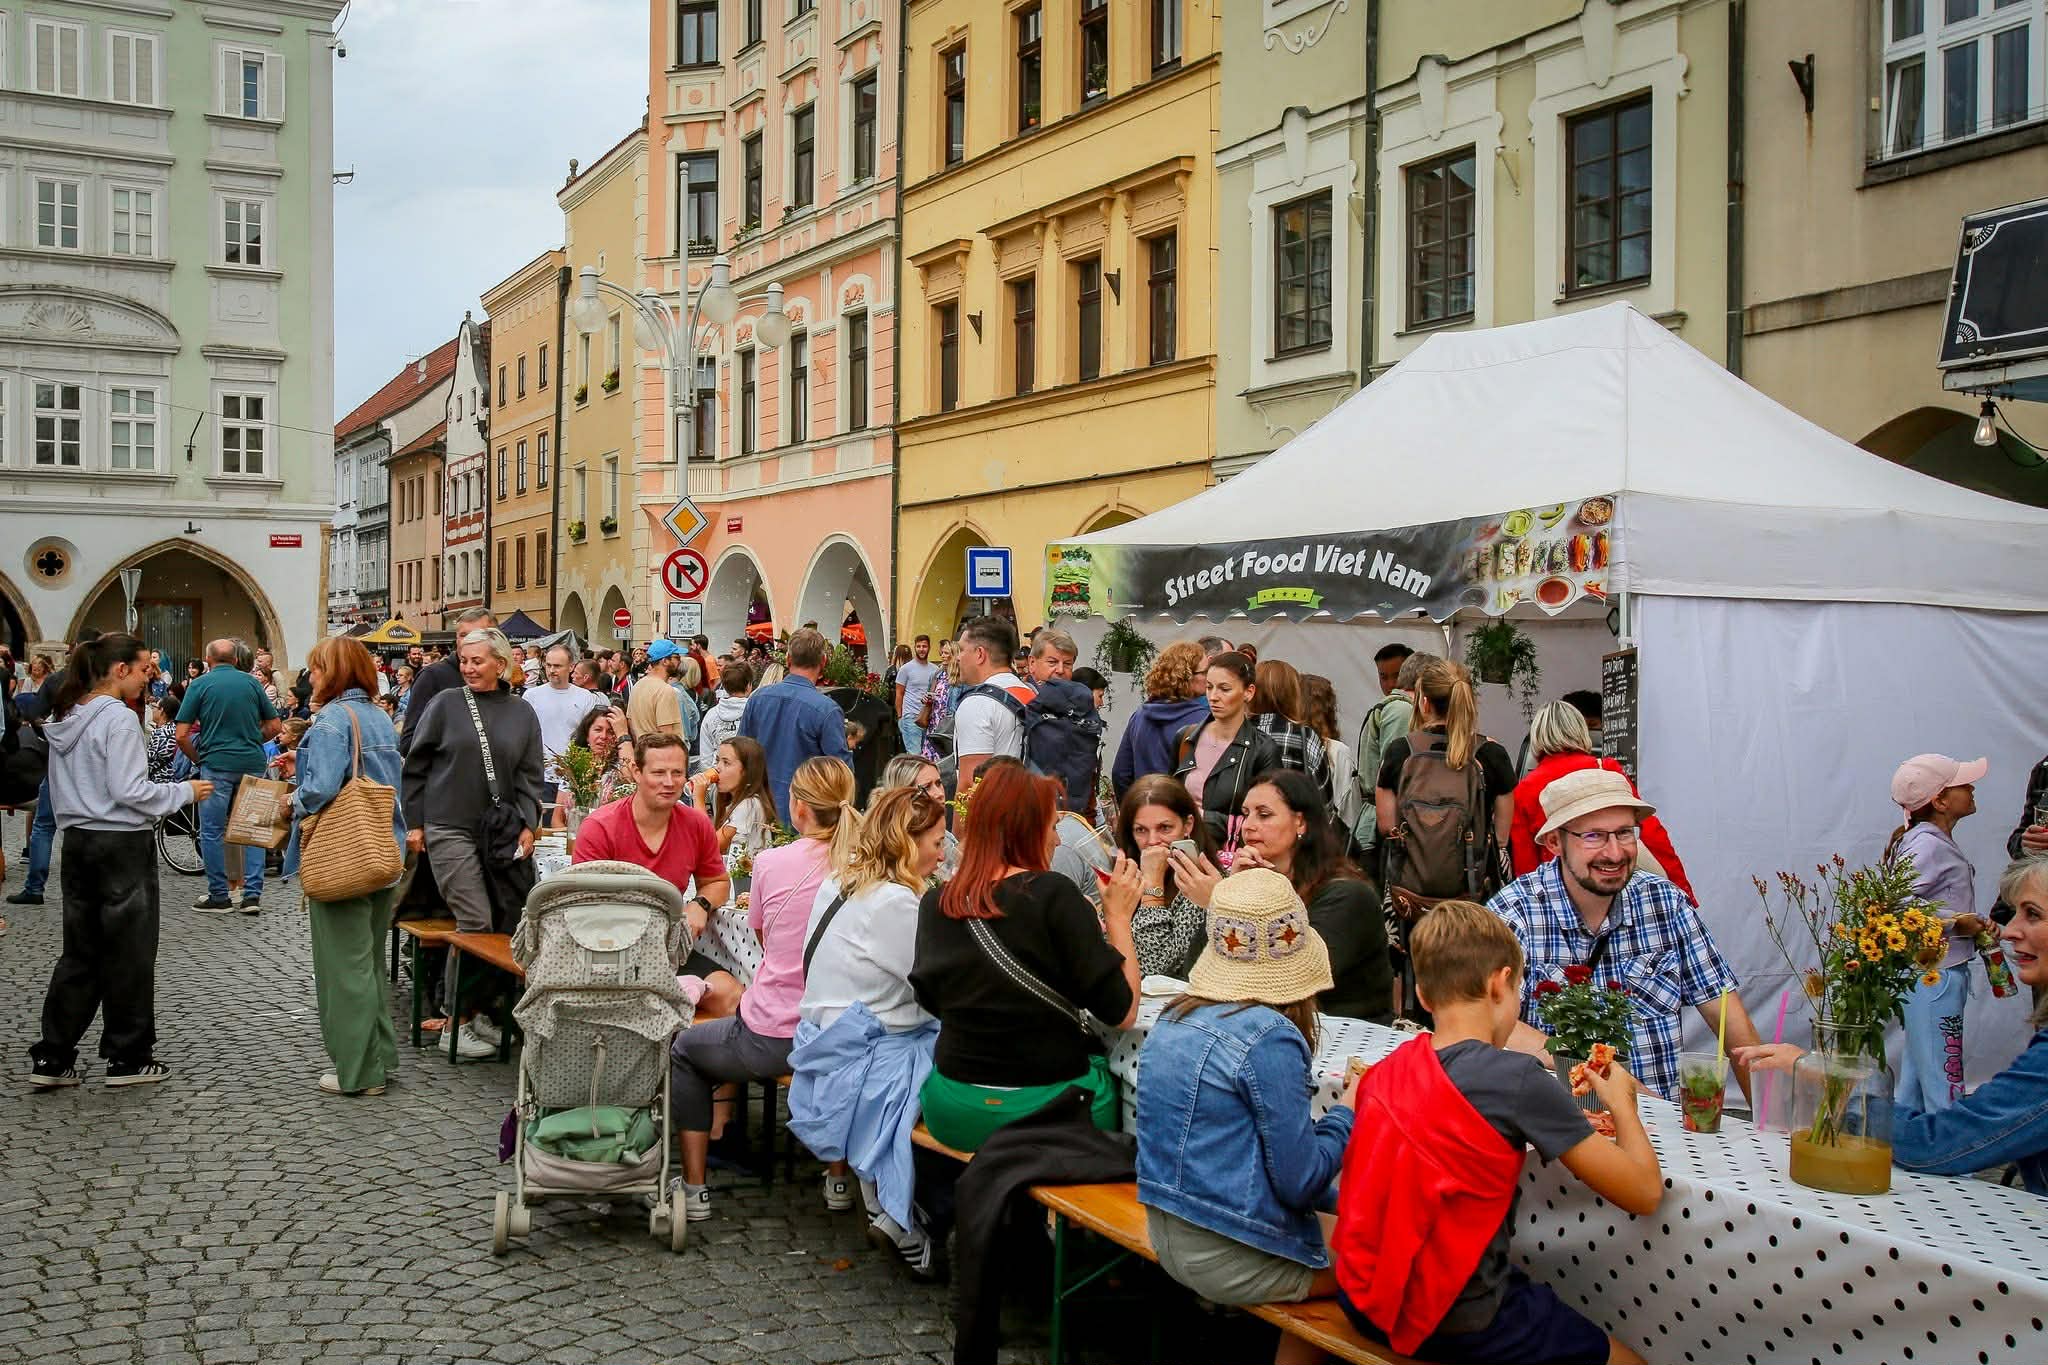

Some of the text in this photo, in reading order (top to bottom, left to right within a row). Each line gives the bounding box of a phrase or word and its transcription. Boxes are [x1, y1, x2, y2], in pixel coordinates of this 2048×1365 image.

[1164, 544, 1433, 607] Street Food Viet Nam
